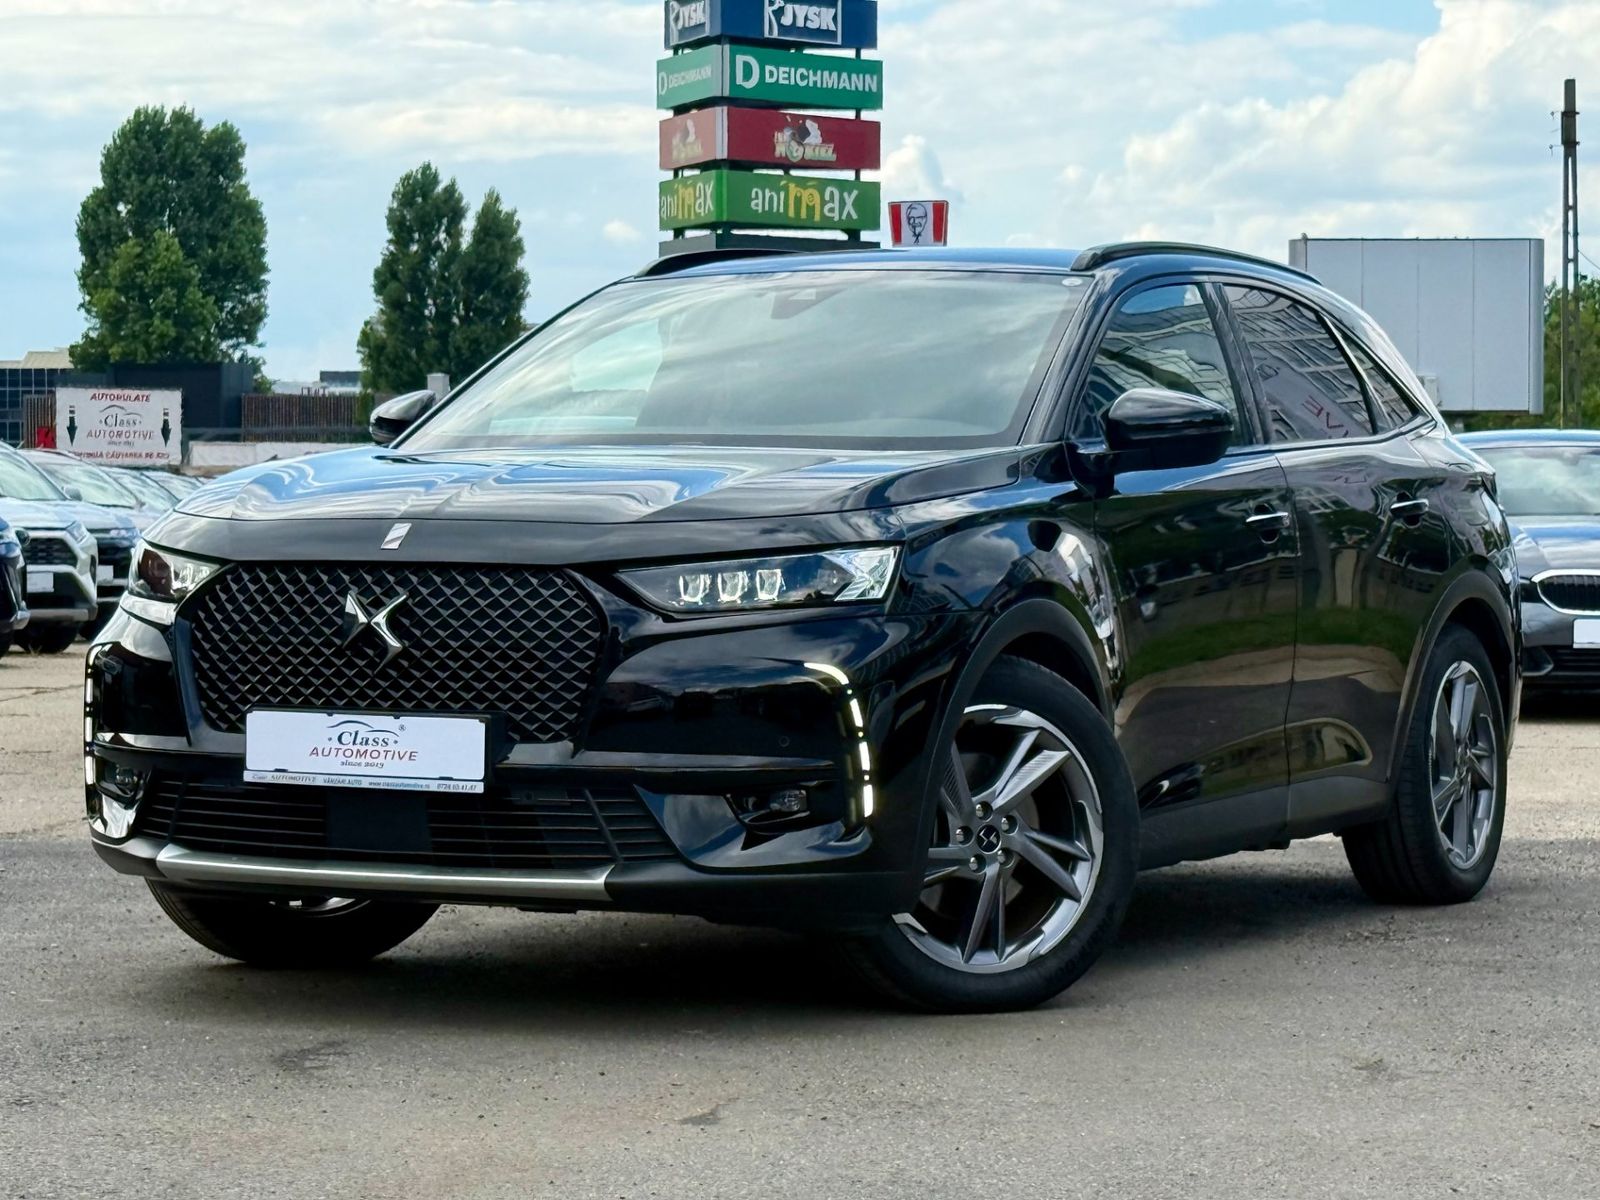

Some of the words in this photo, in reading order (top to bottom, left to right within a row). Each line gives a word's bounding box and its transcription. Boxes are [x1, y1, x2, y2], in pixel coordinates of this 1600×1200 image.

[677, 2, 706, 30] JYSK
[780, 4, 837, 31] JYSK
[668, 65, 712, 89] DEICHMANN
[765, 65, 878, 93] DEICHMANN
[660, 180, 715, 221] animax
[750, 181, 859, 222] animax
[86, 429, 155, 441] AUTOMOTIVE
[337, 729, 390, 747] Class
[309, 746, 419, 761] AUTOMOTIVE
